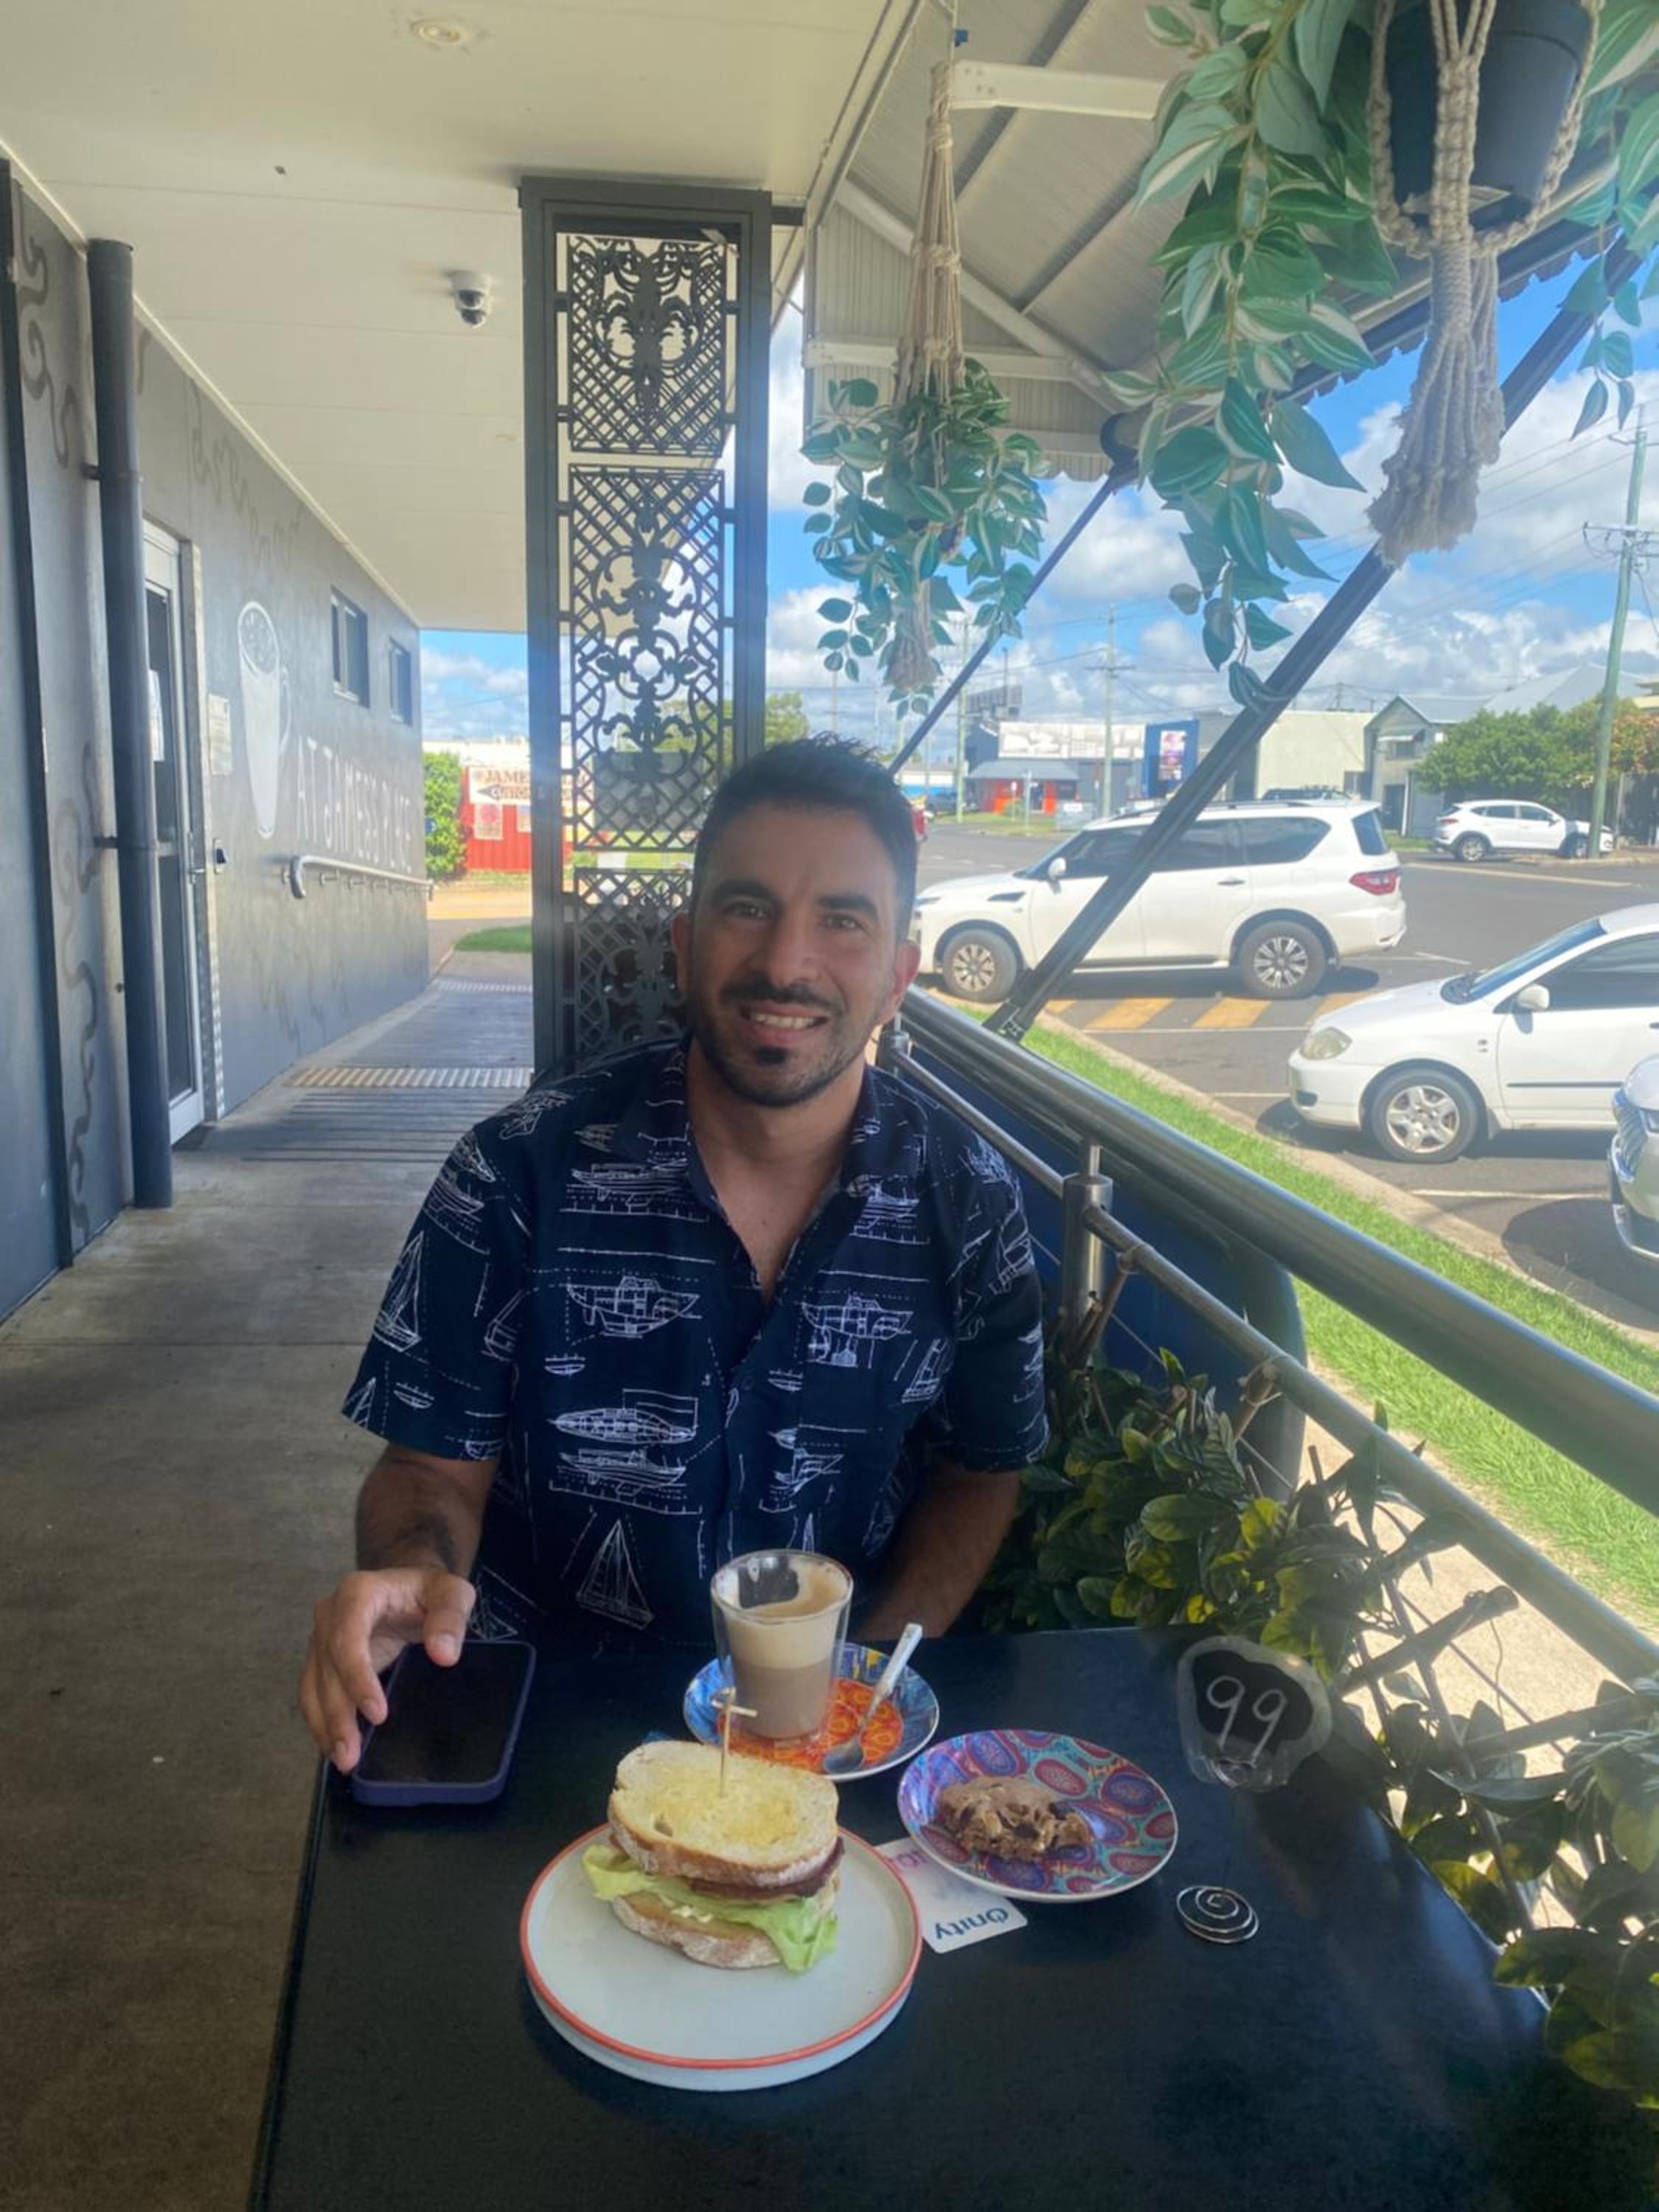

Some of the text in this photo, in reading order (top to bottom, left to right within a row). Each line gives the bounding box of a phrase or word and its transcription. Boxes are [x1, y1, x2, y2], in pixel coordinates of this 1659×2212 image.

[297, 734, 317, 843] AT
[486, 770, 529, 783] JAME
[1207, 1675, 1287, 1764] 99
